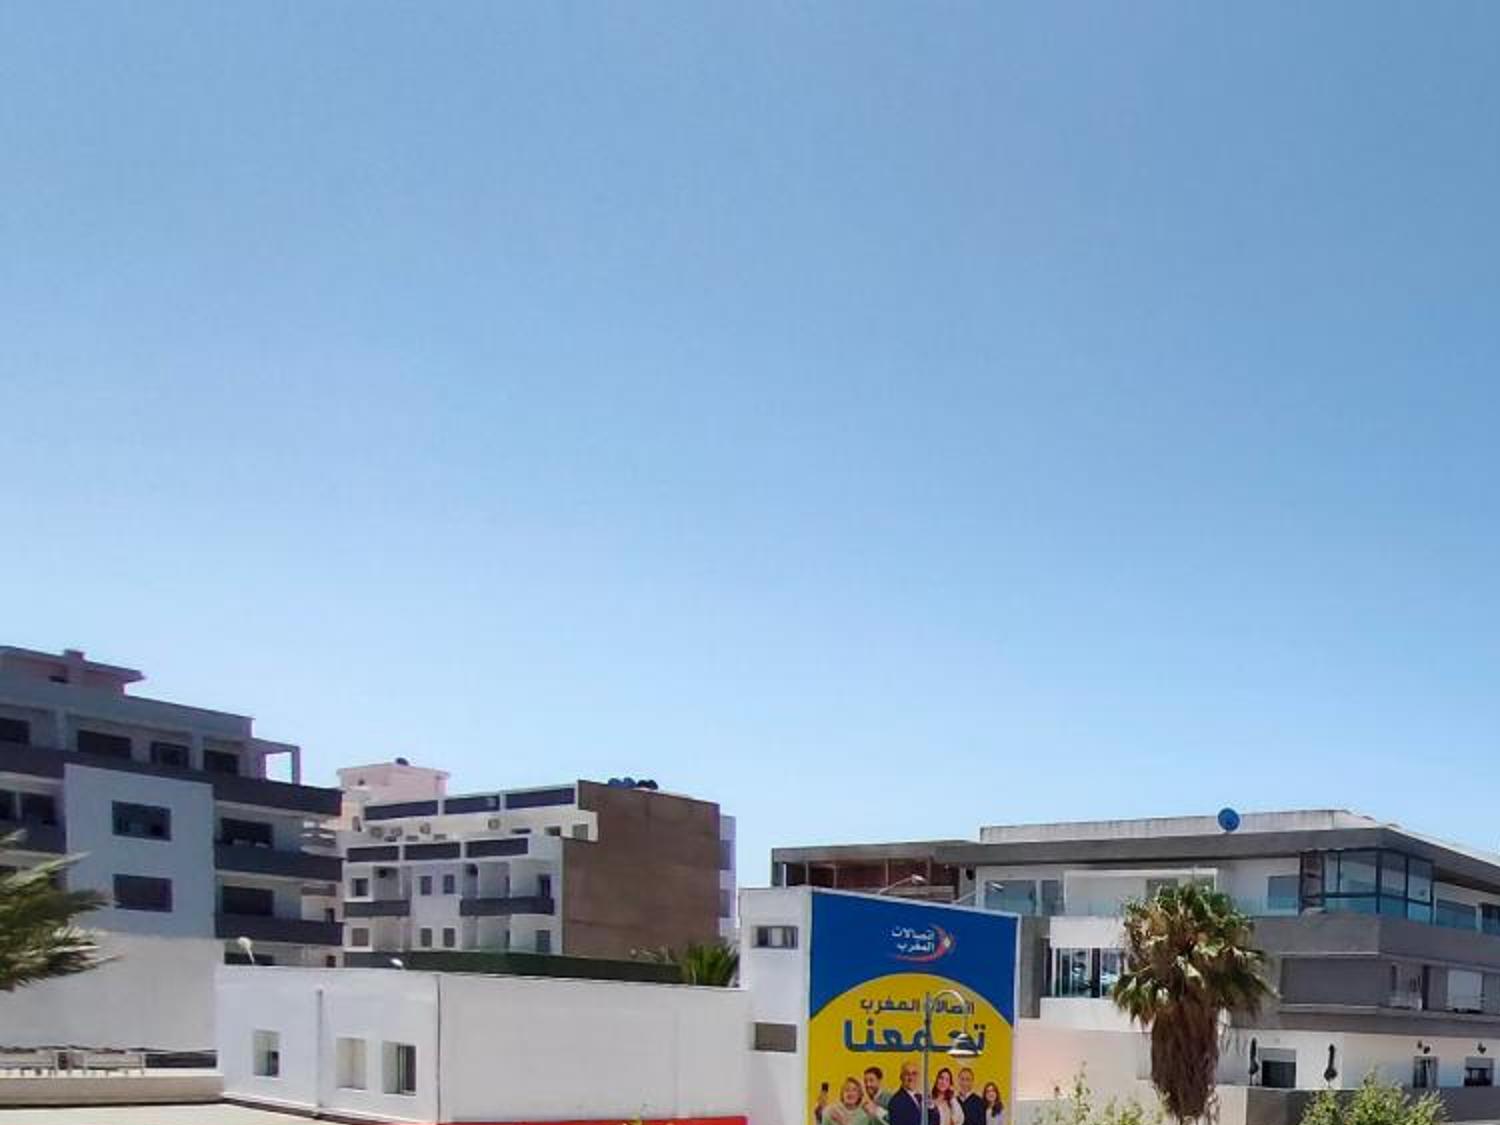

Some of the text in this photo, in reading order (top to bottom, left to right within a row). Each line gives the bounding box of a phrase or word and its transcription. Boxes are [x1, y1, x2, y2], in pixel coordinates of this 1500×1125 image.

[891, 926, 935, 940] اتصالات
[896, 940, 935, 953] المغرب
[860, 996, 920, 1015] المغرب
